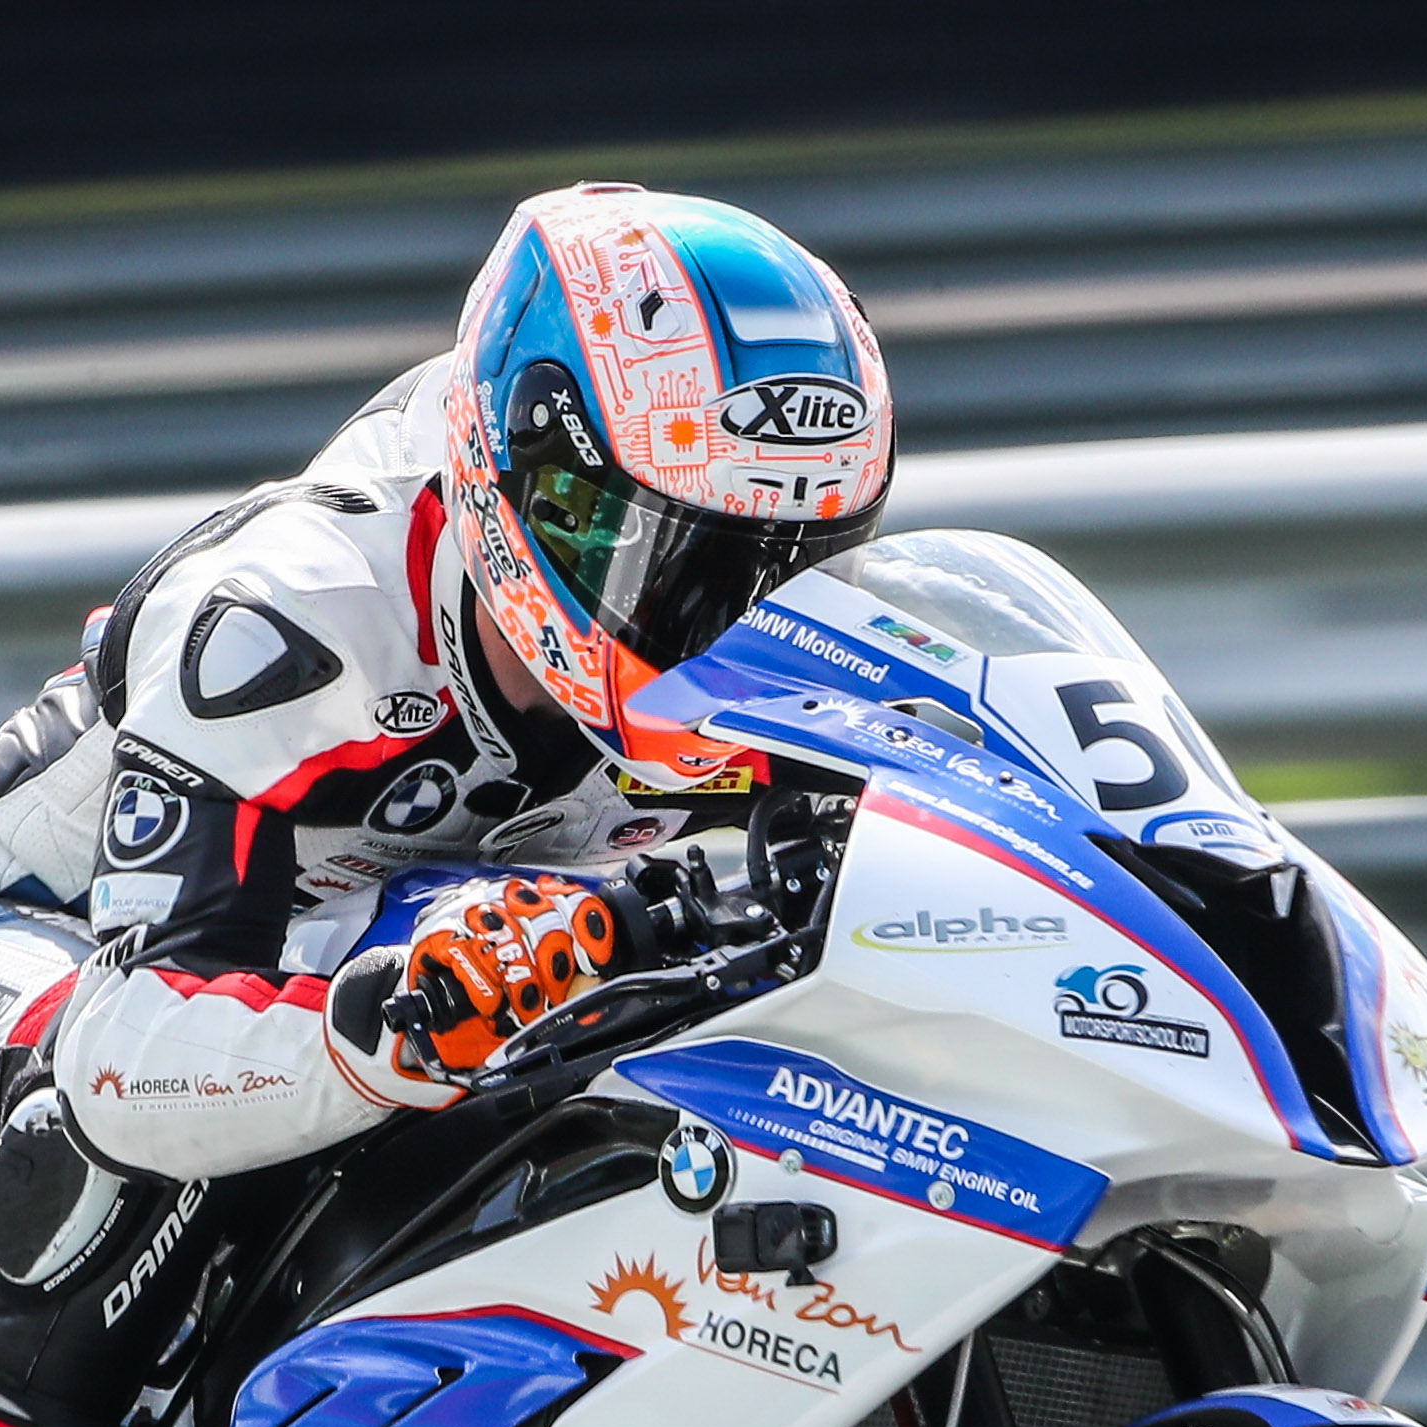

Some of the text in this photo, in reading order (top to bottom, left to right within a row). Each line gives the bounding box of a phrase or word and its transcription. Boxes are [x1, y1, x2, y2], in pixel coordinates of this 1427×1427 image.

[739, 386, 857, 437] X-lite
[540, 625, 570, 672] 55
[738, 606, 796, 641] BMW
[792, 626, 891, 684] Motorrad
[867, 615, 957, 662] MRA
[381, 695, 434, 727] X-lite
[544, 666, 603, 720] 55
[116, 738, 205, 788] DAMEN
[867, 720, 944, 760] HOECA
[872, 907, 1067, 944] alpha
[129, 1070, 297, 1097] HORECA Van Zon
[766, 1066, 970, 1161] ADVANTEC
[809, 1119, 1041, 1214] ORIGINAL BMW ENGINE OIL
[794, 1281, 923, 1353] Zon
[697, 1310, 844, 1385] HORECA
